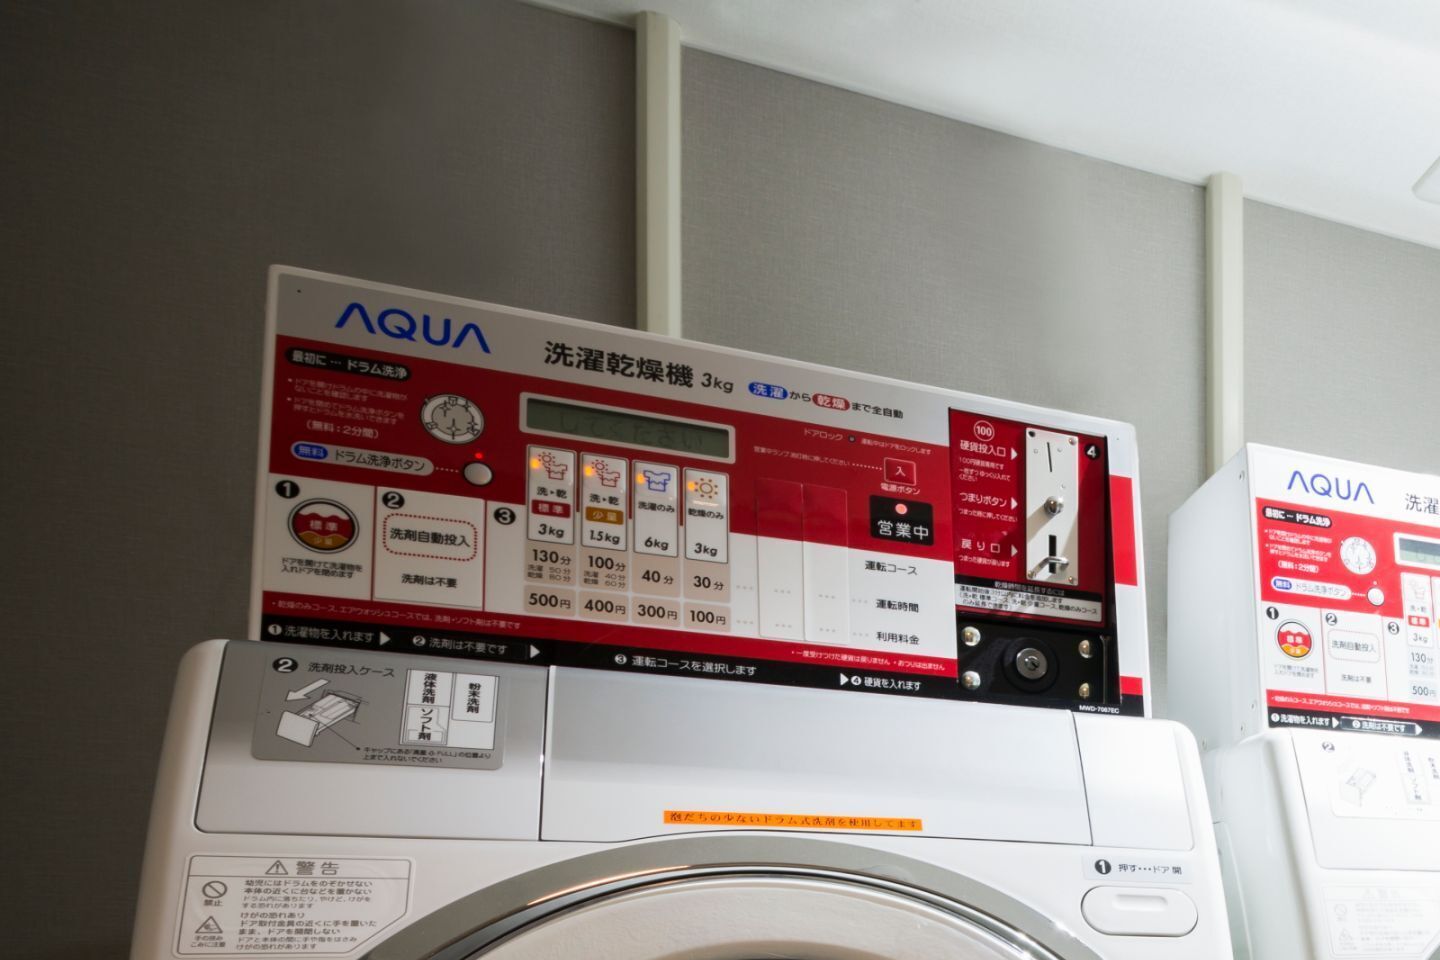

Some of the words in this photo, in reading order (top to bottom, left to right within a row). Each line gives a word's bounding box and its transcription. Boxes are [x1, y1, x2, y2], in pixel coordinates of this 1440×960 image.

[335, 302, 491, 354] AQUA
[544, 340, 694, 388] 洗濯乾燥機
[701, 371, 735, 394] 3kg
[975, 426, 992, 437] 100
[959, 439, 1006, 458] 硬貨投入口
[335, 448, 425, 472] ドラム洗浄ボタン
[895, 465, 906, 477] 入
[1287, 470, 1375, 504] AQUA
[637, 500, 676, 514] 洗濯のみ
[959, 491, 1007, 507] つまりボタン
[389, 527, 471, 548] 洗剤自動投入
[538, 523, 565, 539] 3kg
[589, 529, 621, 546] 1.5kg
[877, 519, 930, 541] 営業中
[644, 536, 669, 551] 6kg
[694, 542, 718, 557] 3kg
[532, 549, 572, 566] 130分
[588, 555, 626, 572] 100分
[641, 569, 674, 585] 40分
[864, 560, 919, 577] 運転コース
[401, 573, 458, 589] 洗剤は不要
[693, 575, 725, 592] 30分
[528, 592, 572, 610] 500円
[584, 599, 626, 615] 400円
[876, 598, 920, 615] 運転時間
[637, 604, 678, 620] 300円
[690, 610, 726, 626] 100円
[285, 624, 375, 642] 洗濯物を入れます
[876, 630, 920, 646] 利用料金
[429, 636, 507, 655] 洗剤は不要です
[308, 661, 395, 678] 洗剤投入ケース
[631, 655, 757, 677] 運転コースを選択します
[421, 672, 438, 704] 液体洗剤
[863, 676, 921, 692] 硬貨を入れます
[466, 682, 482, 714] 粉末洗剤
[418, 707, 433, 741] ソフト剤
[296, 860, 340, 876] 警告
